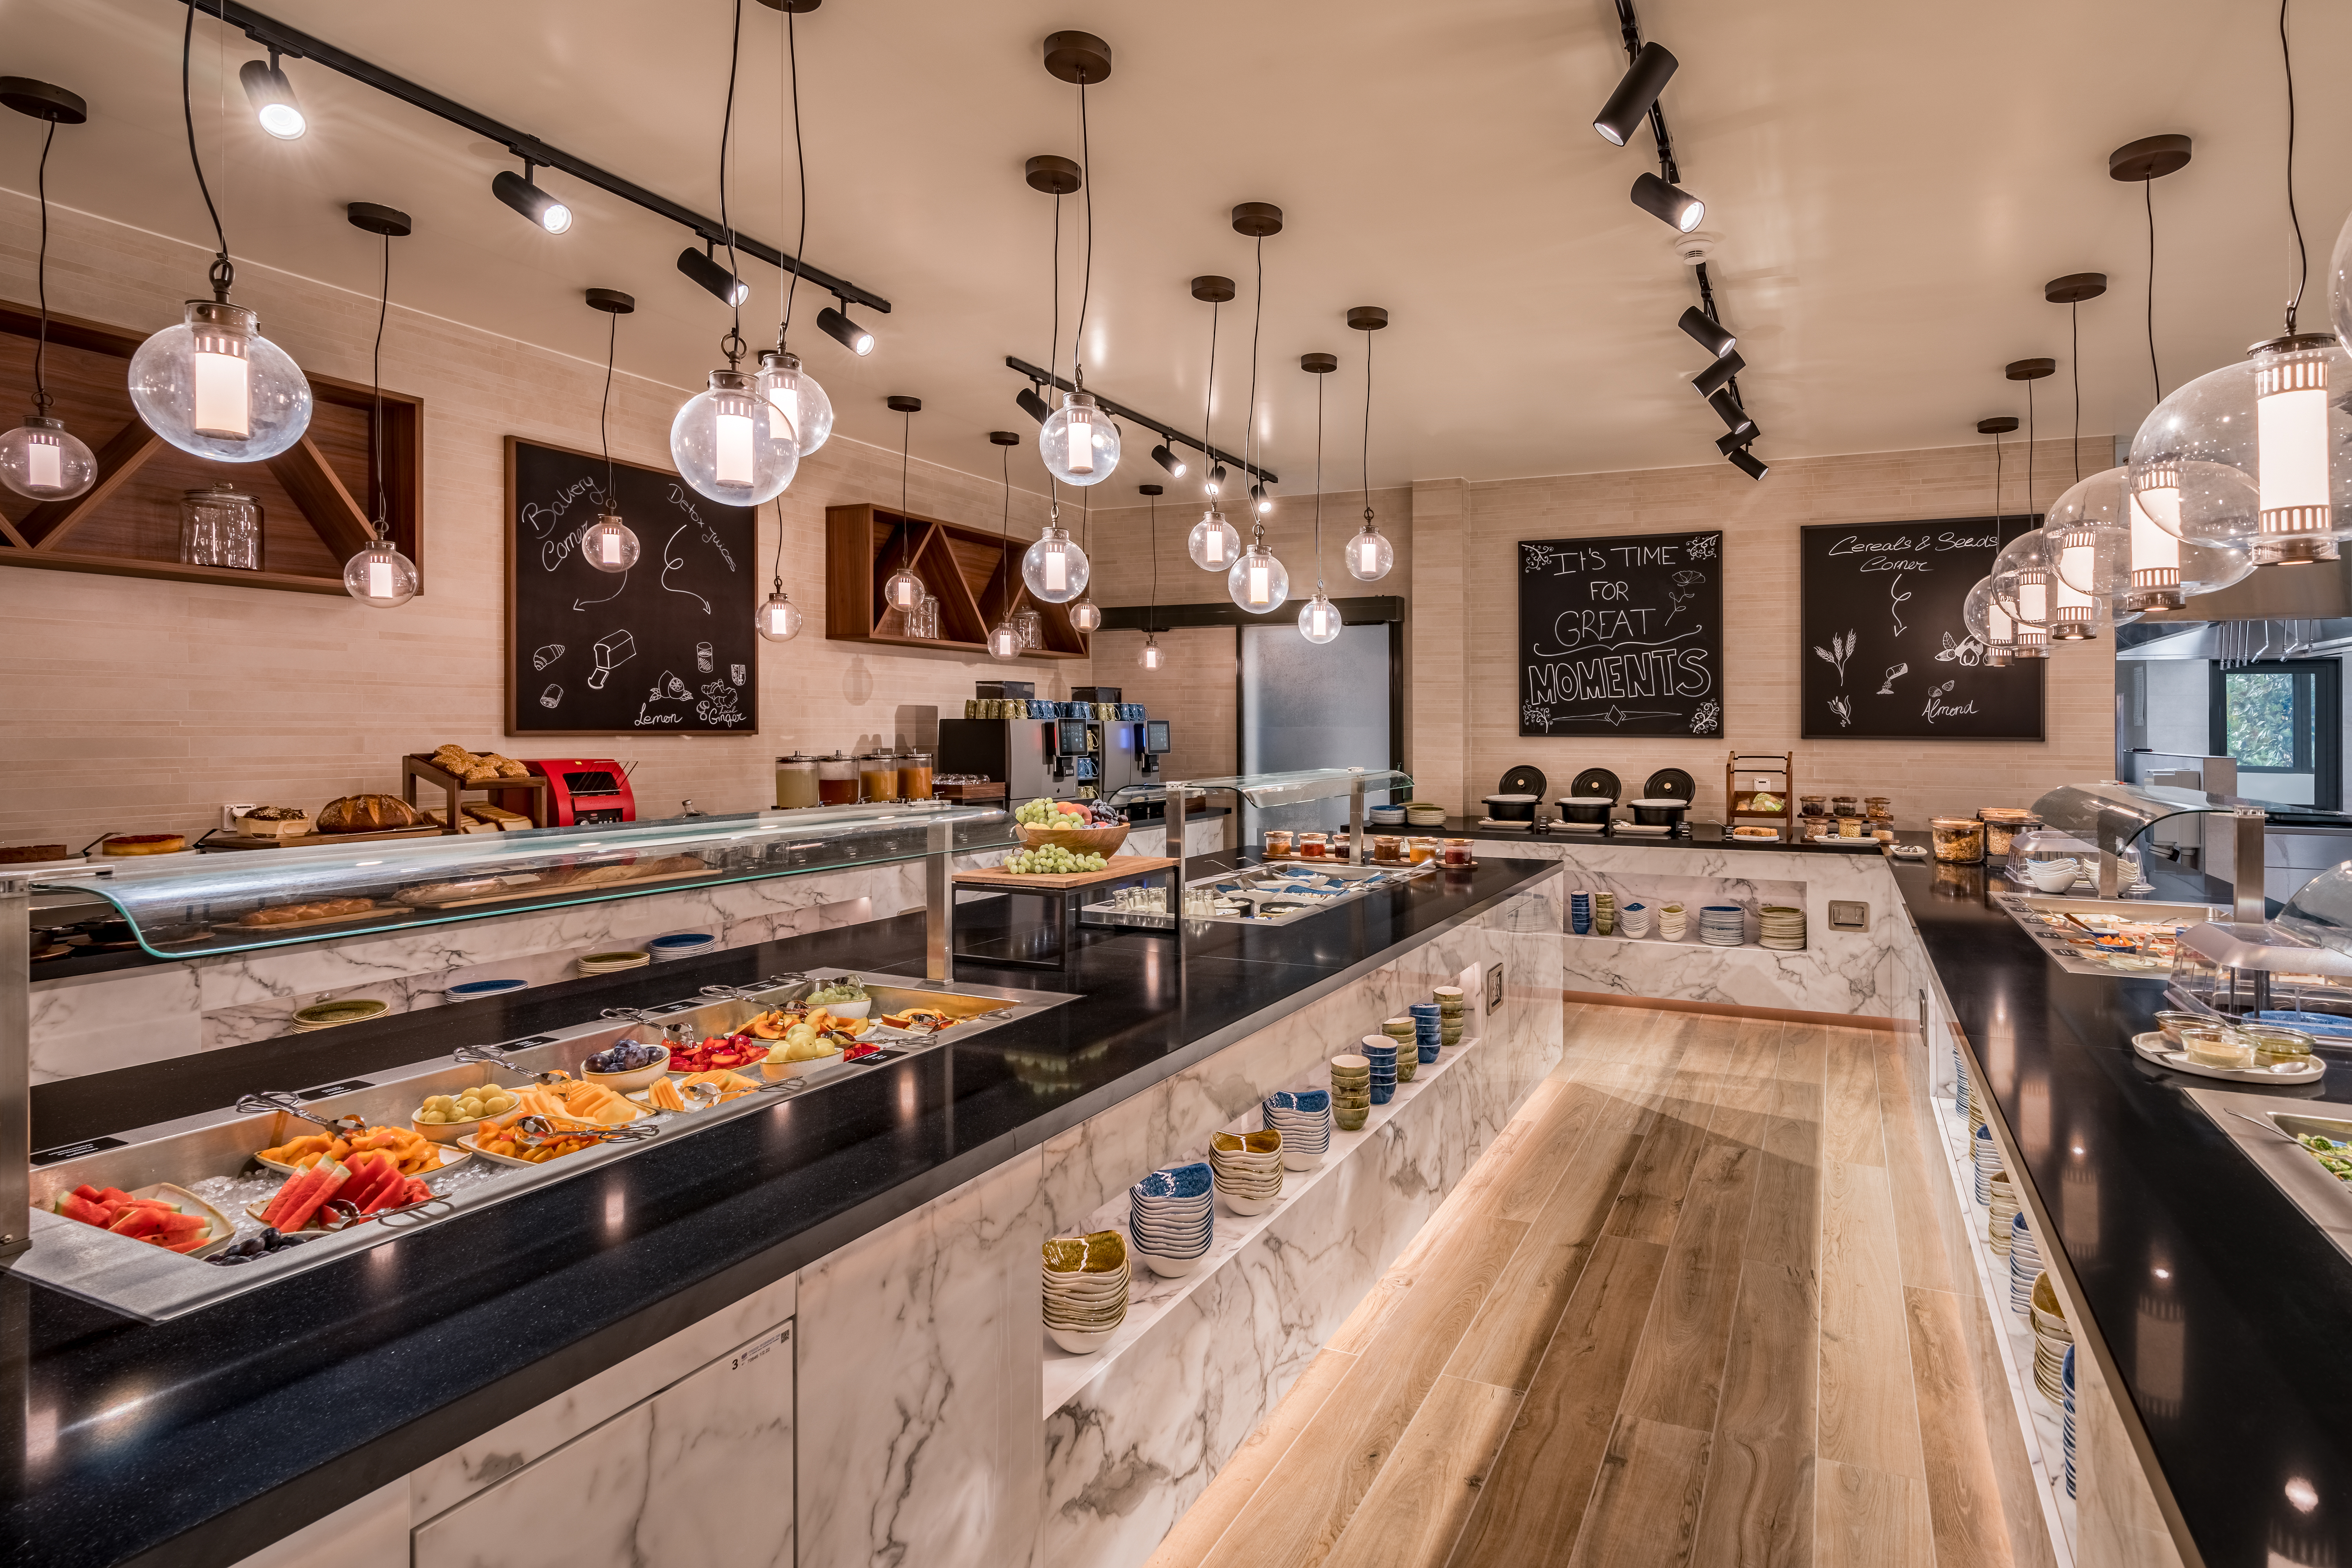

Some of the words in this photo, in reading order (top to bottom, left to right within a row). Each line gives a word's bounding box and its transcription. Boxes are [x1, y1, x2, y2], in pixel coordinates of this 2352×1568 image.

[522, 476, 606, 539] Bakery
[666, 483, 705, 528] Detox
[542, 520, 588, 572] Corner
[1828, 535, 1911, 556] Cereals
[1915, 535, 1931, 551] &
[1935, 532, 1998, 551] Seeds
[1610, 546, 1679, 567] TIME
[1860, 556, 1935, 572] Corner
[1590, 581, 1629, 601] FOR
[1555, 608, 1656, 646] GREAT
[1528, 648, 1711, 705] MOMENTS
[634, 702, 683, 726] Lemon
[709, 708, 747, 728] Ginger
[719, 706, 738, 715] Local
[1921, 698, 1981, 724] Almond
[732, 1358, 738, 1370] 3
